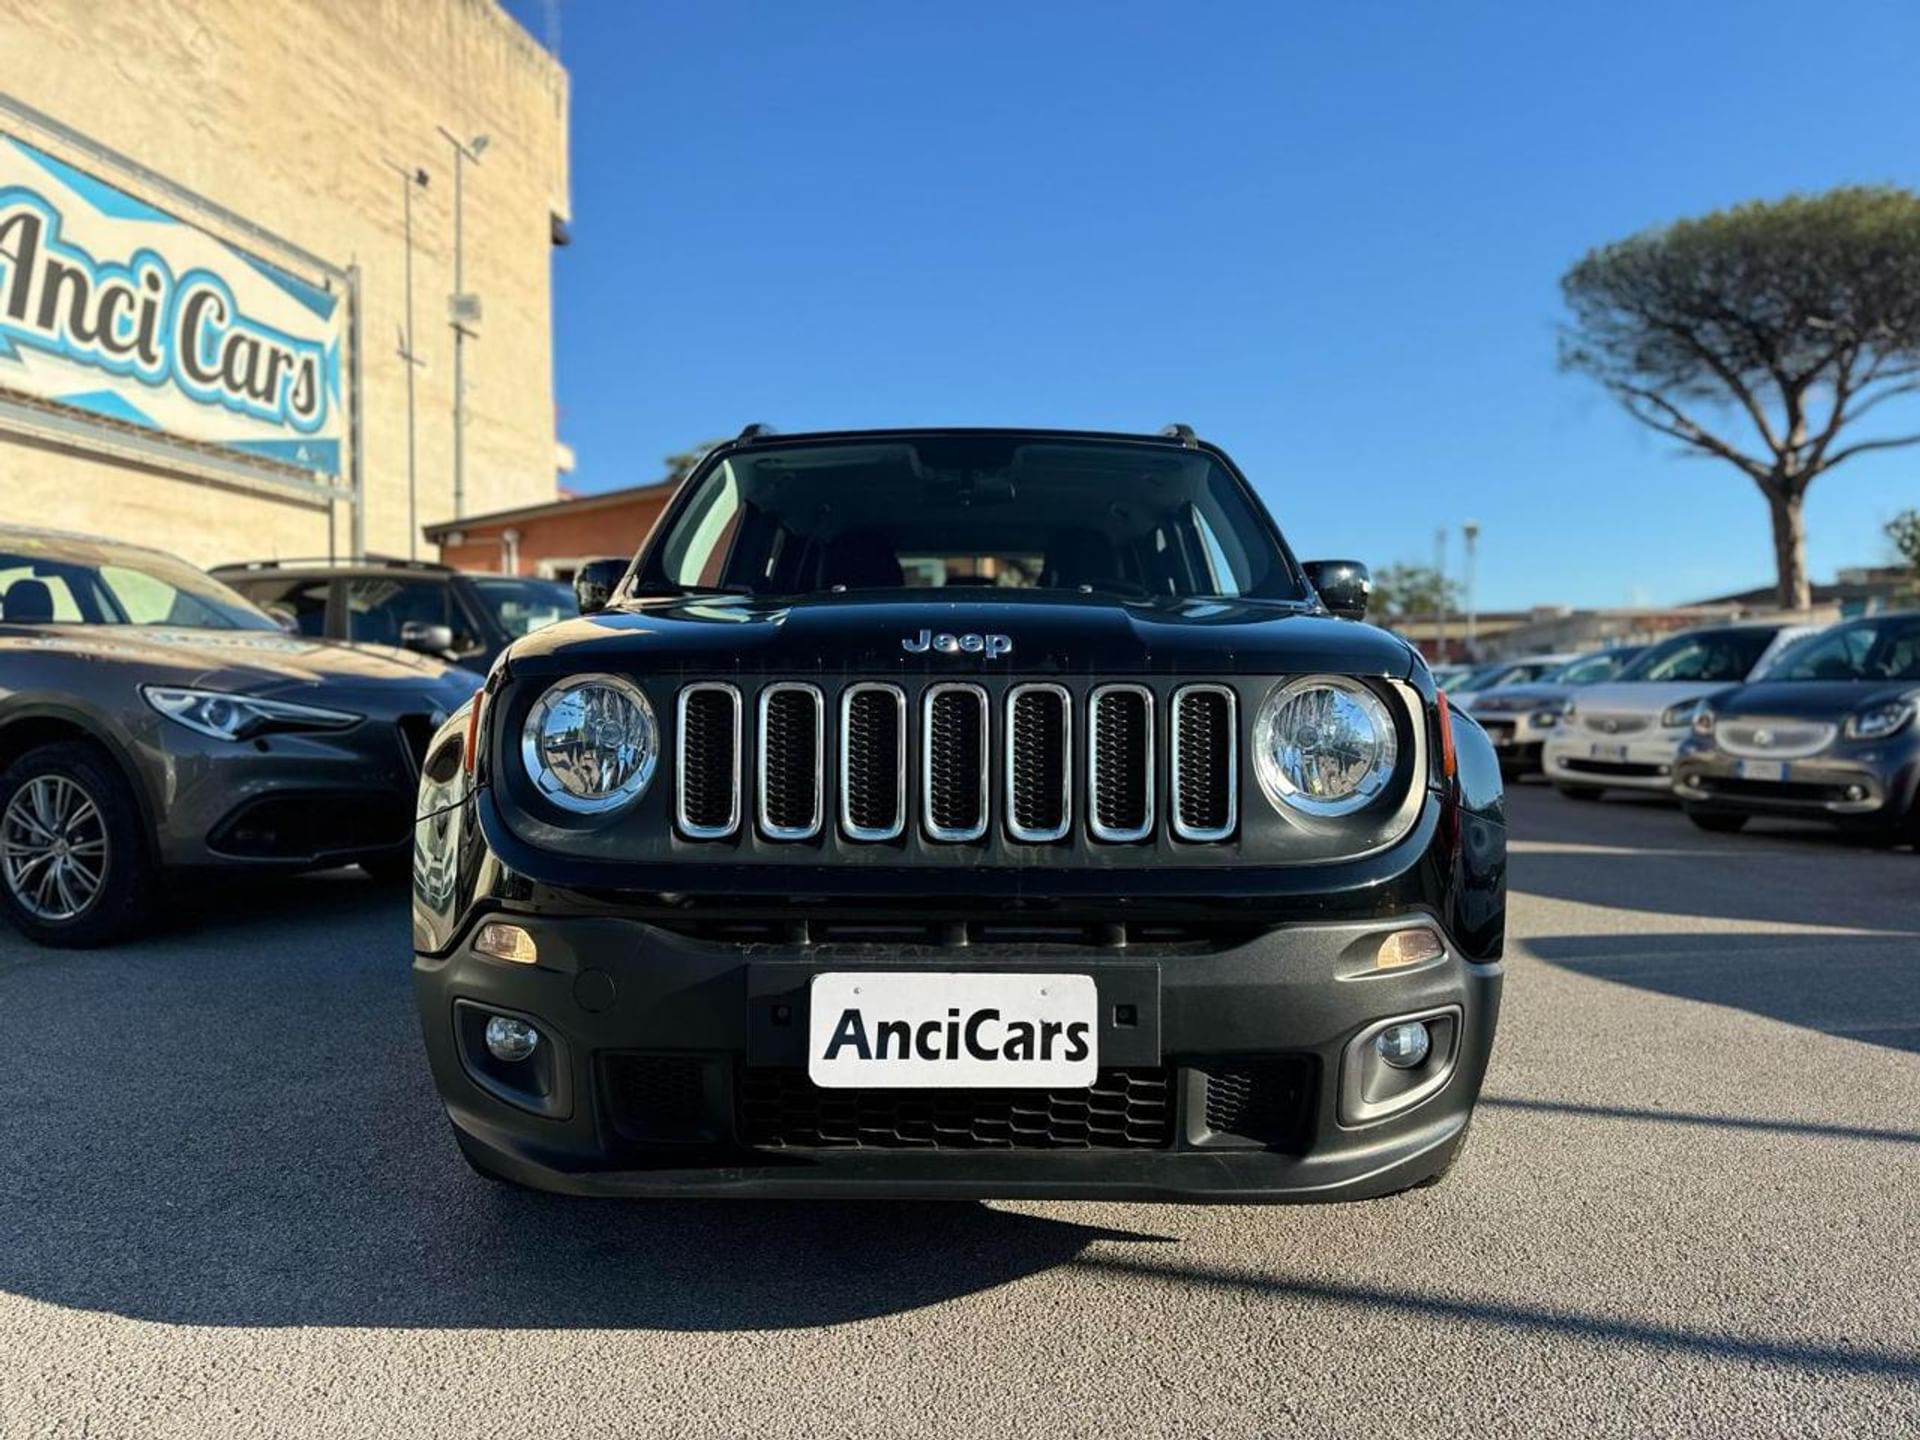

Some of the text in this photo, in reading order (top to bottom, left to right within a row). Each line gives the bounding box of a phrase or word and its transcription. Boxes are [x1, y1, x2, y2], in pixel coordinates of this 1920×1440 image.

[0, 212, 318, 416] Anci Cars
[901, 629, 1013, 659] Jeep
[822, 1007, 1091, 1062] AnciCars
